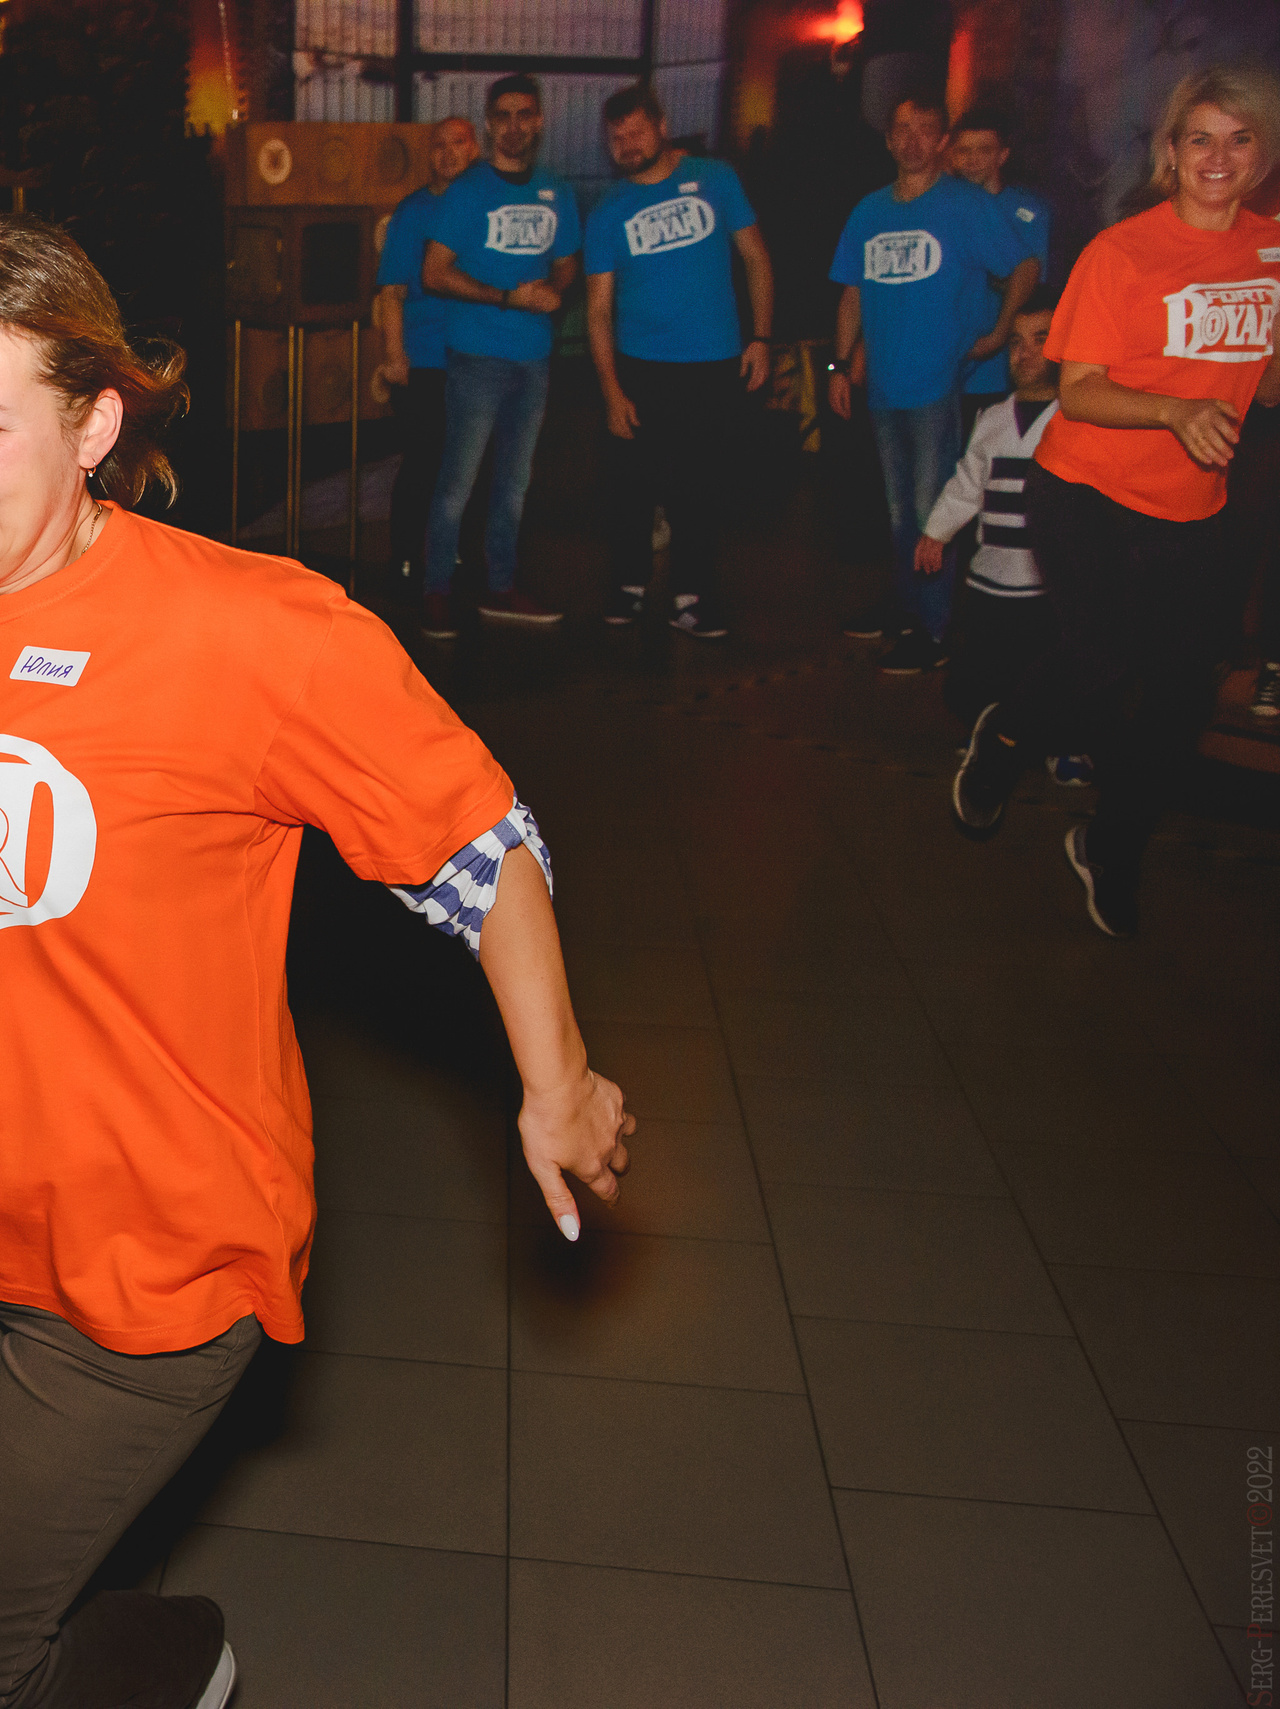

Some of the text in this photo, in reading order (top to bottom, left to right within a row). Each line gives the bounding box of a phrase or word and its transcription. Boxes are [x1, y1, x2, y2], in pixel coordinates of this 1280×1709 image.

[1205, 288, 1270, 304] FORT
[1163, 283, 1277, 362] BOYAR
[20, 655, 74, 678] Юлия
